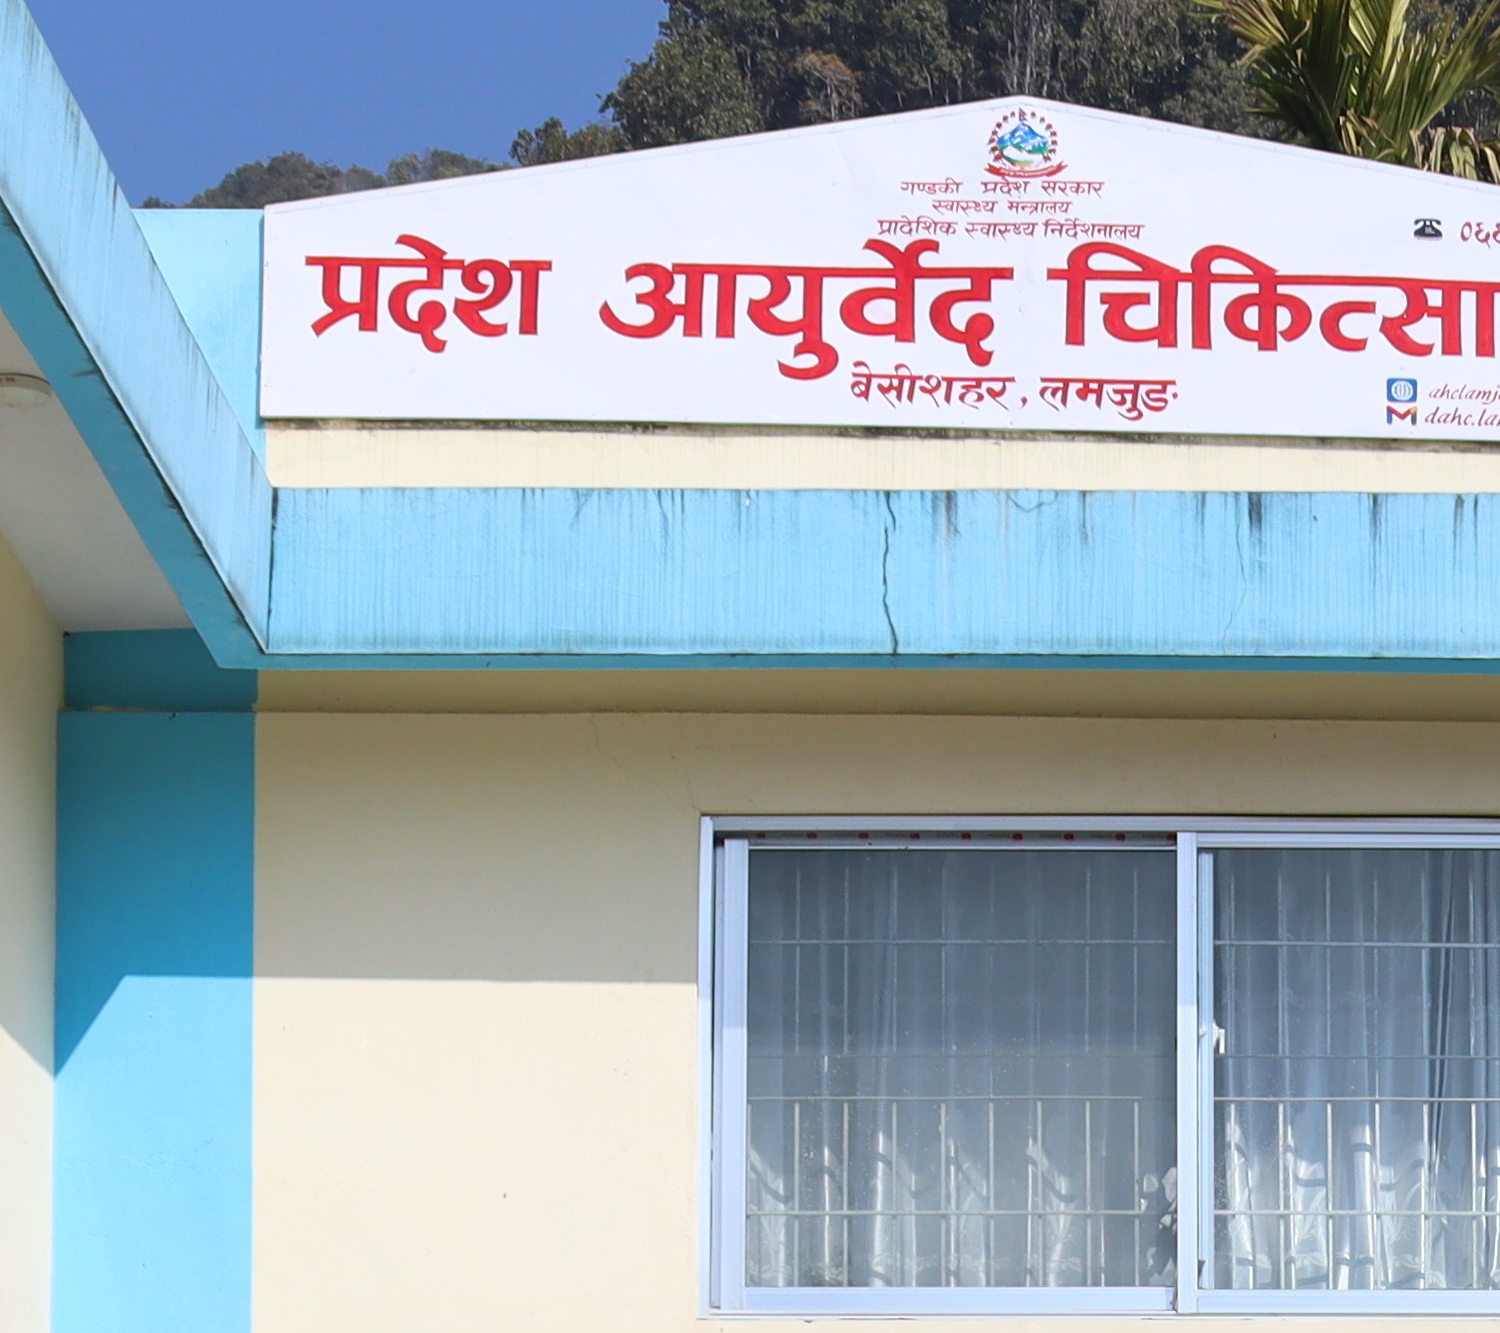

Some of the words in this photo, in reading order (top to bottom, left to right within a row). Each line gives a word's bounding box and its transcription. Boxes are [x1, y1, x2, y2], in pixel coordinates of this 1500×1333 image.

[900, 177, 963, 195] गण्डकी
[981, 177, 1030, 197] प्रदेश
[1040, 181, 1105, 198] सरकार
[932, 200, 998, 216] स्वास्थ्य
[1007, 200, 1073, 216] मन्त्रालय
[877, 215, 958, 237] प्रादेशिक
[964, 221, 1038, 239] स्वास्थ्य
[1042, 217, 1145, 240] निर्देशनालय
[304, 235, 552, 352] प्रदेश
[599, 238, 1014, 379] आयुर्वेद
[1039, 377, 1179, 421] लमजुङ
